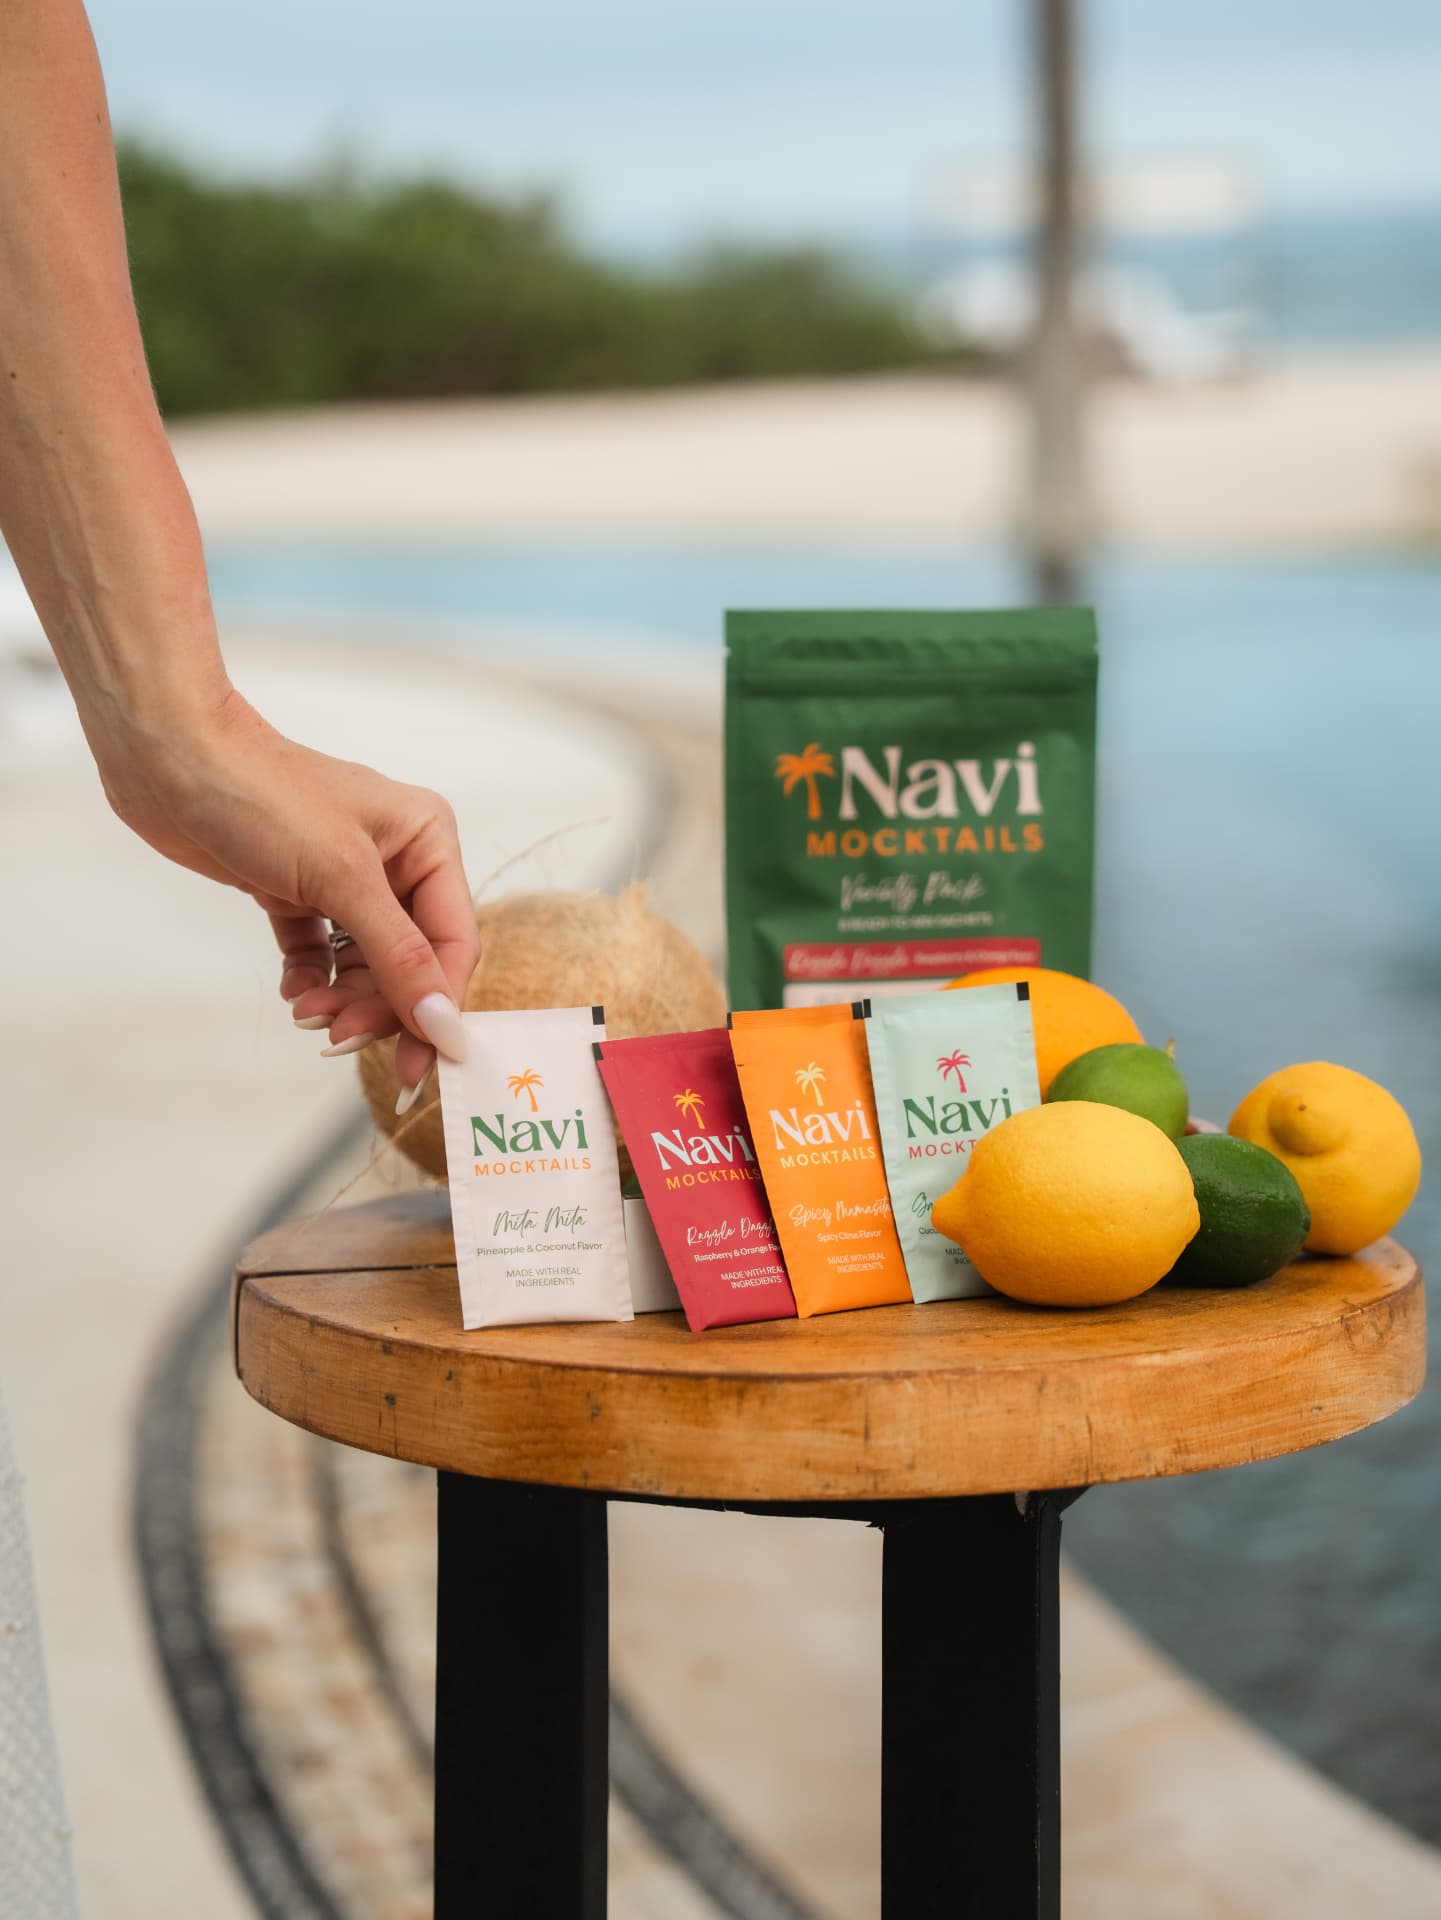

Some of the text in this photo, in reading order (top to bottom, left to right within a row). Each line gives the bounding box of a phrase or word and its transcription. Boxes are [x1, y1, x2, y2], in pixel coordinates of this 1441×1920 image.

[838, 741, 1044, 820] Navi
[806, 824, 1045, 858] MOCKTAILS
[903, 1087, 1013, 1138] Navi
[470, 1109, 589, 1157] Navi
[769, 1100, 871, 1150] Navi
[650, 1125, 755, 1171] Navi
[780, 1146, 877, 1169] MOCKTAILS
[908, 1138, 977, 1159] MOCKT
[474, 1157, 593, 1177] MOCKTAILS
[665, 1168, 761, 1191] MOCKTAILS
[492, 1205, 588, 1239] Mita Mita
[789, 1203, 833, 1228] Spicy
[687, 1216, 776, 1247] Razzle Dazzl
[816, 1229, 882, 1243] Spicy Citrus Flavor
[476, 1241, 603, 1257] Pineapple & Coconut Flavor
[693, 1251, 733, 1263] Raspberry
[733, 1249, 740, 1257] &
[740, 1246, 768, 1256] Orange
[827, 1252, 885, 1265] MADE WITH REAL
[944, 1247, 965, 1257] MAD
[506, 1266, 583, 1278] MADE WITH REAL
[721, 1265, 785, 1281] MADE WITH REAL
[837, 1261, 884, 1273] INGREDIENTS
[515, 1278, 575, 1288] INGREDIENTS
[730, 1275, 783, 1289] INGREDIENTS
